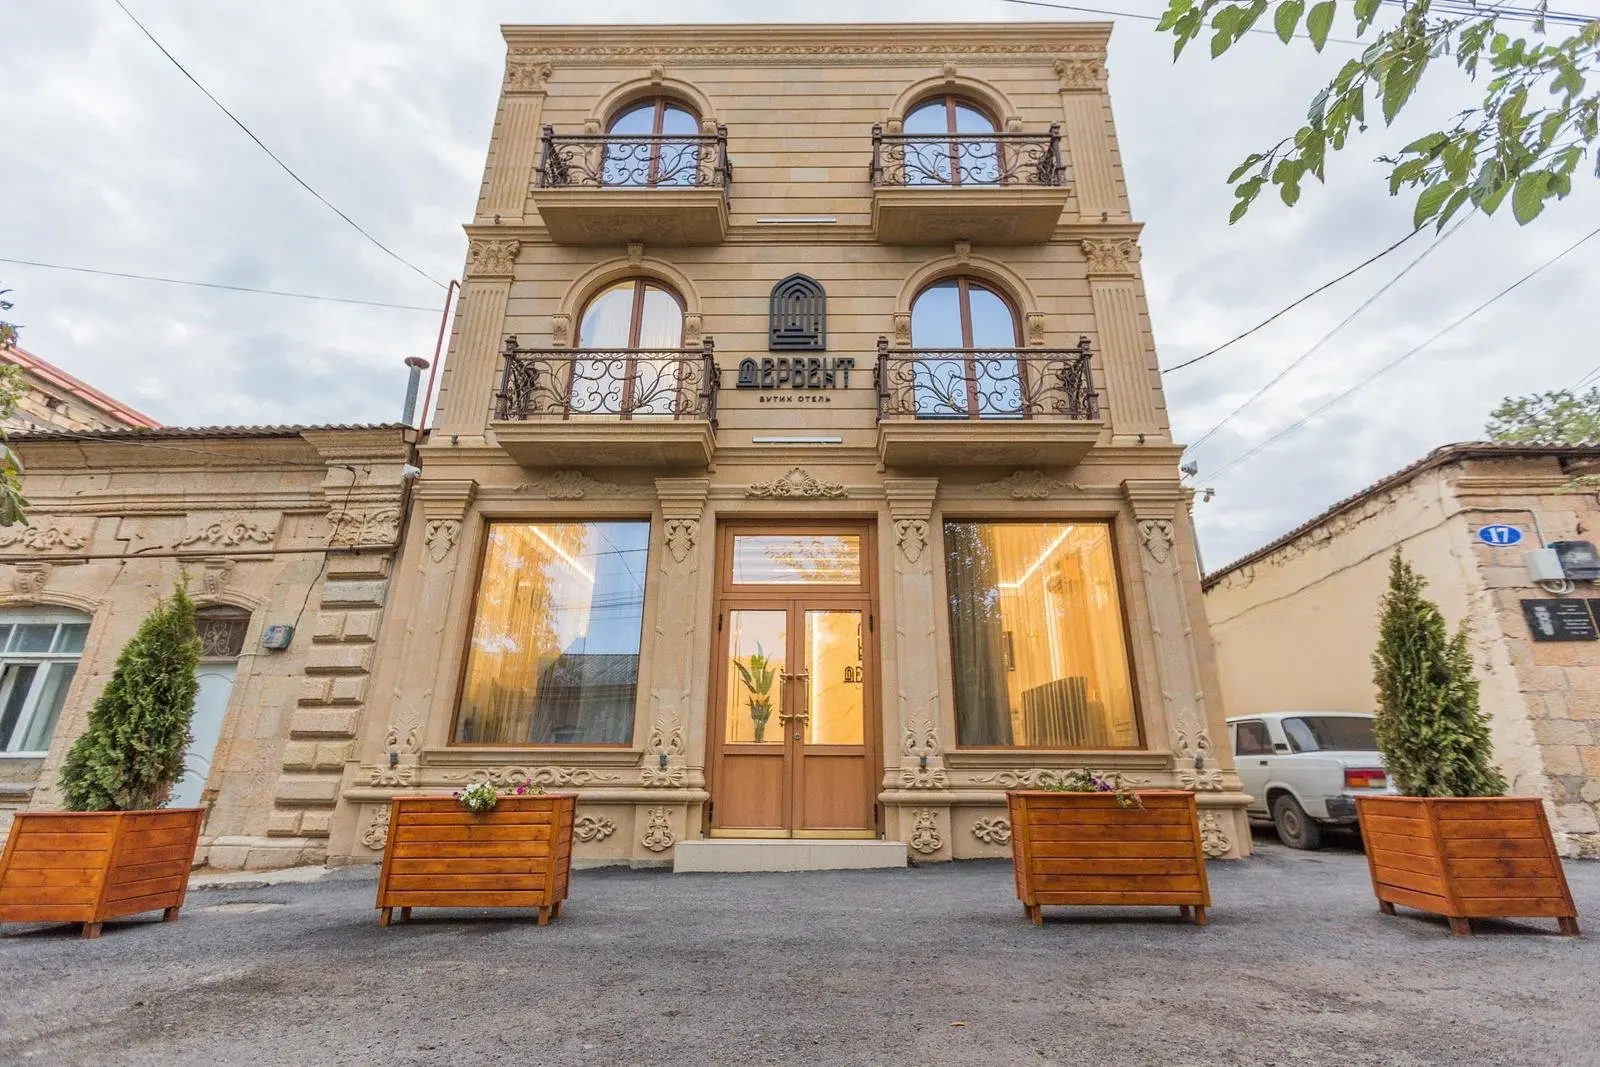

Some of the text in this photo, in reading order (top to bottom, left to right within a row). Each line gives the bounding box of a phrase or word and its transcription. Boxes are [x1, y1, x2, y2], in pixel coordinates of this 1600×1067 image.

[736, 357, 855, 389] ДЕРБЕНТ
[759, 395, 832, 403] БУТИК ОТЕЛЬ
[1487, 527, 1510, 543] 17
